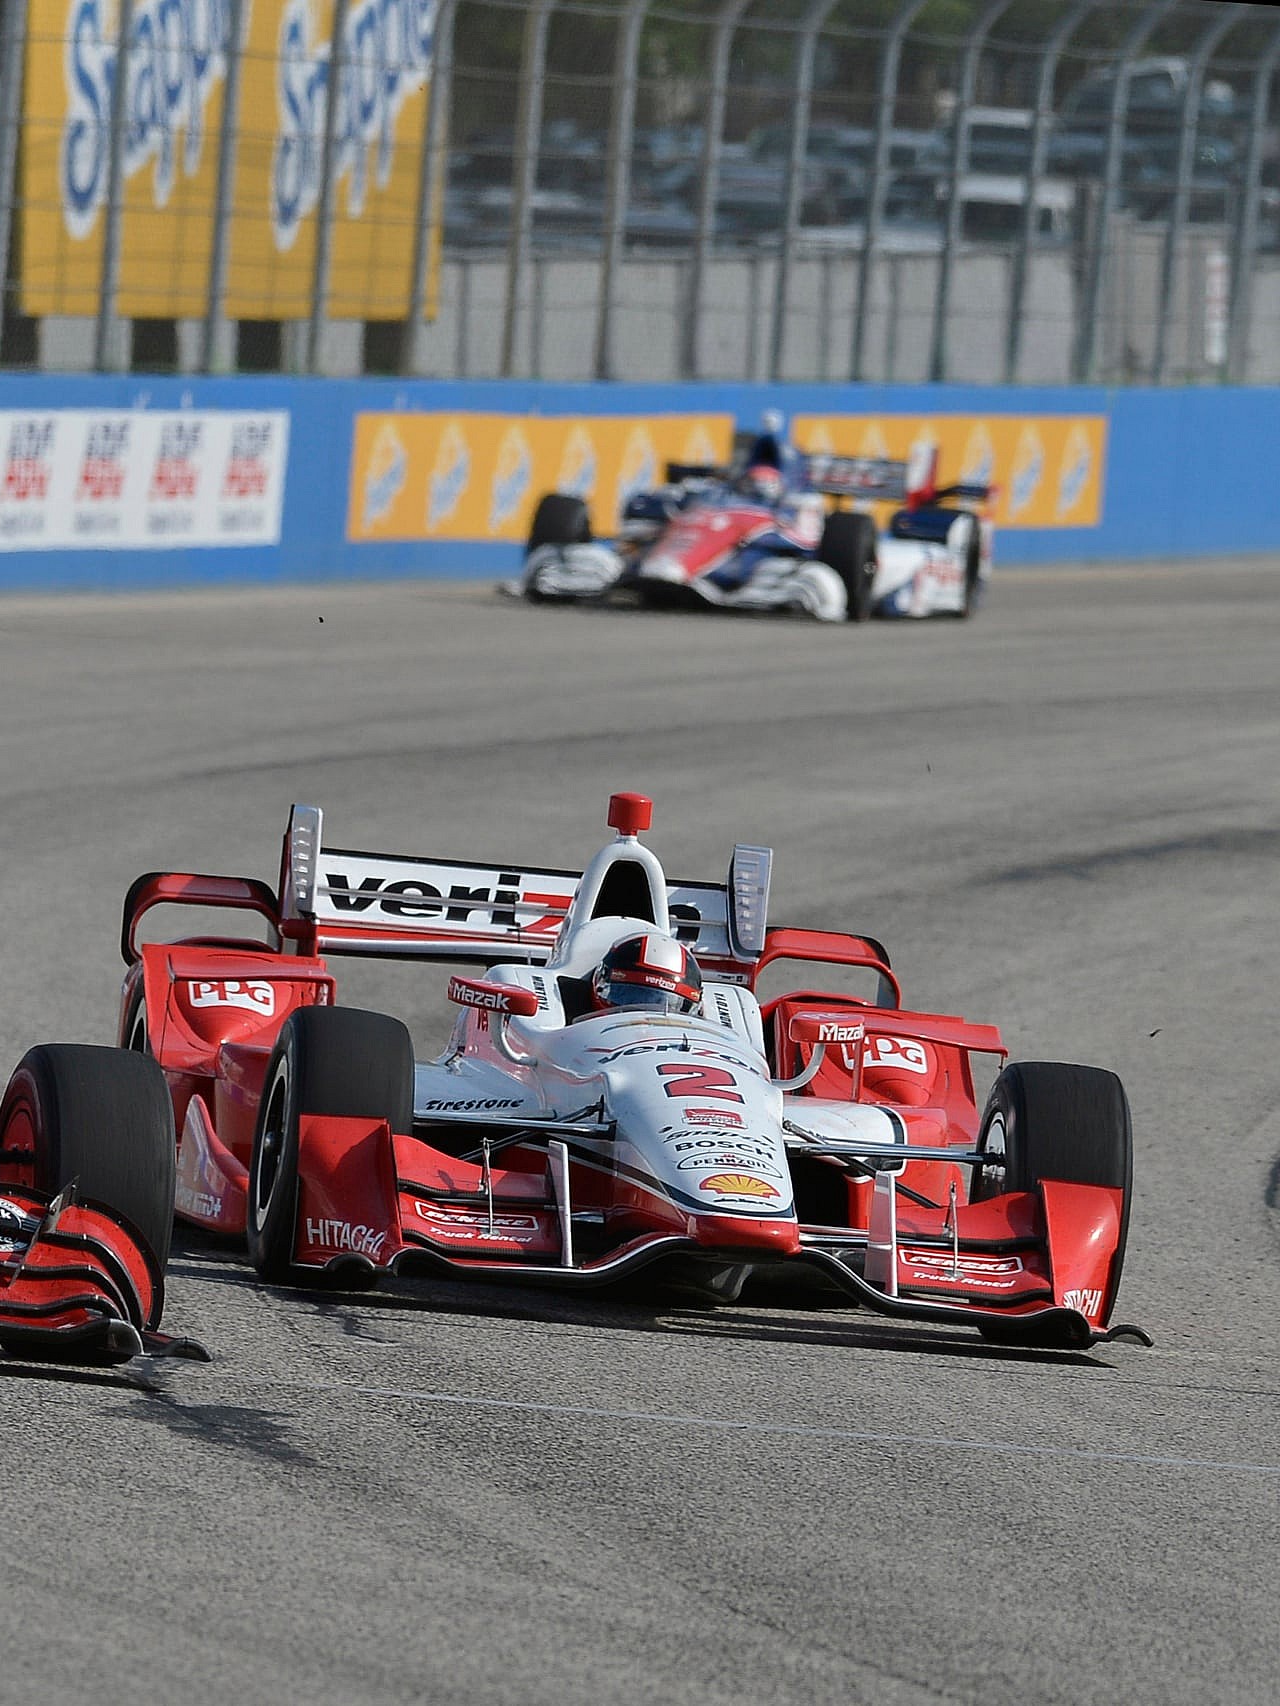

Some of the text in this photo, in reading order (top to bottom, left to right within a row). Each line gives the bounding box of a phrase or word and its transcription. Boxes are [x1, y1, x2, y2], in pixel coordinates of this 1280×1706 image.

[452, 983, 510, 1010] Mazak
[656, 1063, 746, 1105] 2
[426, 1098, 525, 1111] Firestone
[675, 1140, 774, 1160] BOSCH
[693, 1158, 770, 1171] PENNZOIL
[425, 1210, 529, 1226] PENSKE
[306, 1217, 386, 1254] HITACHI
[429, 1226, 533, 1243] Truck Rental
[909, 1255, 1015, 1272] PENSKE
[912, 1271, 1016, 1288] Truck Rental
